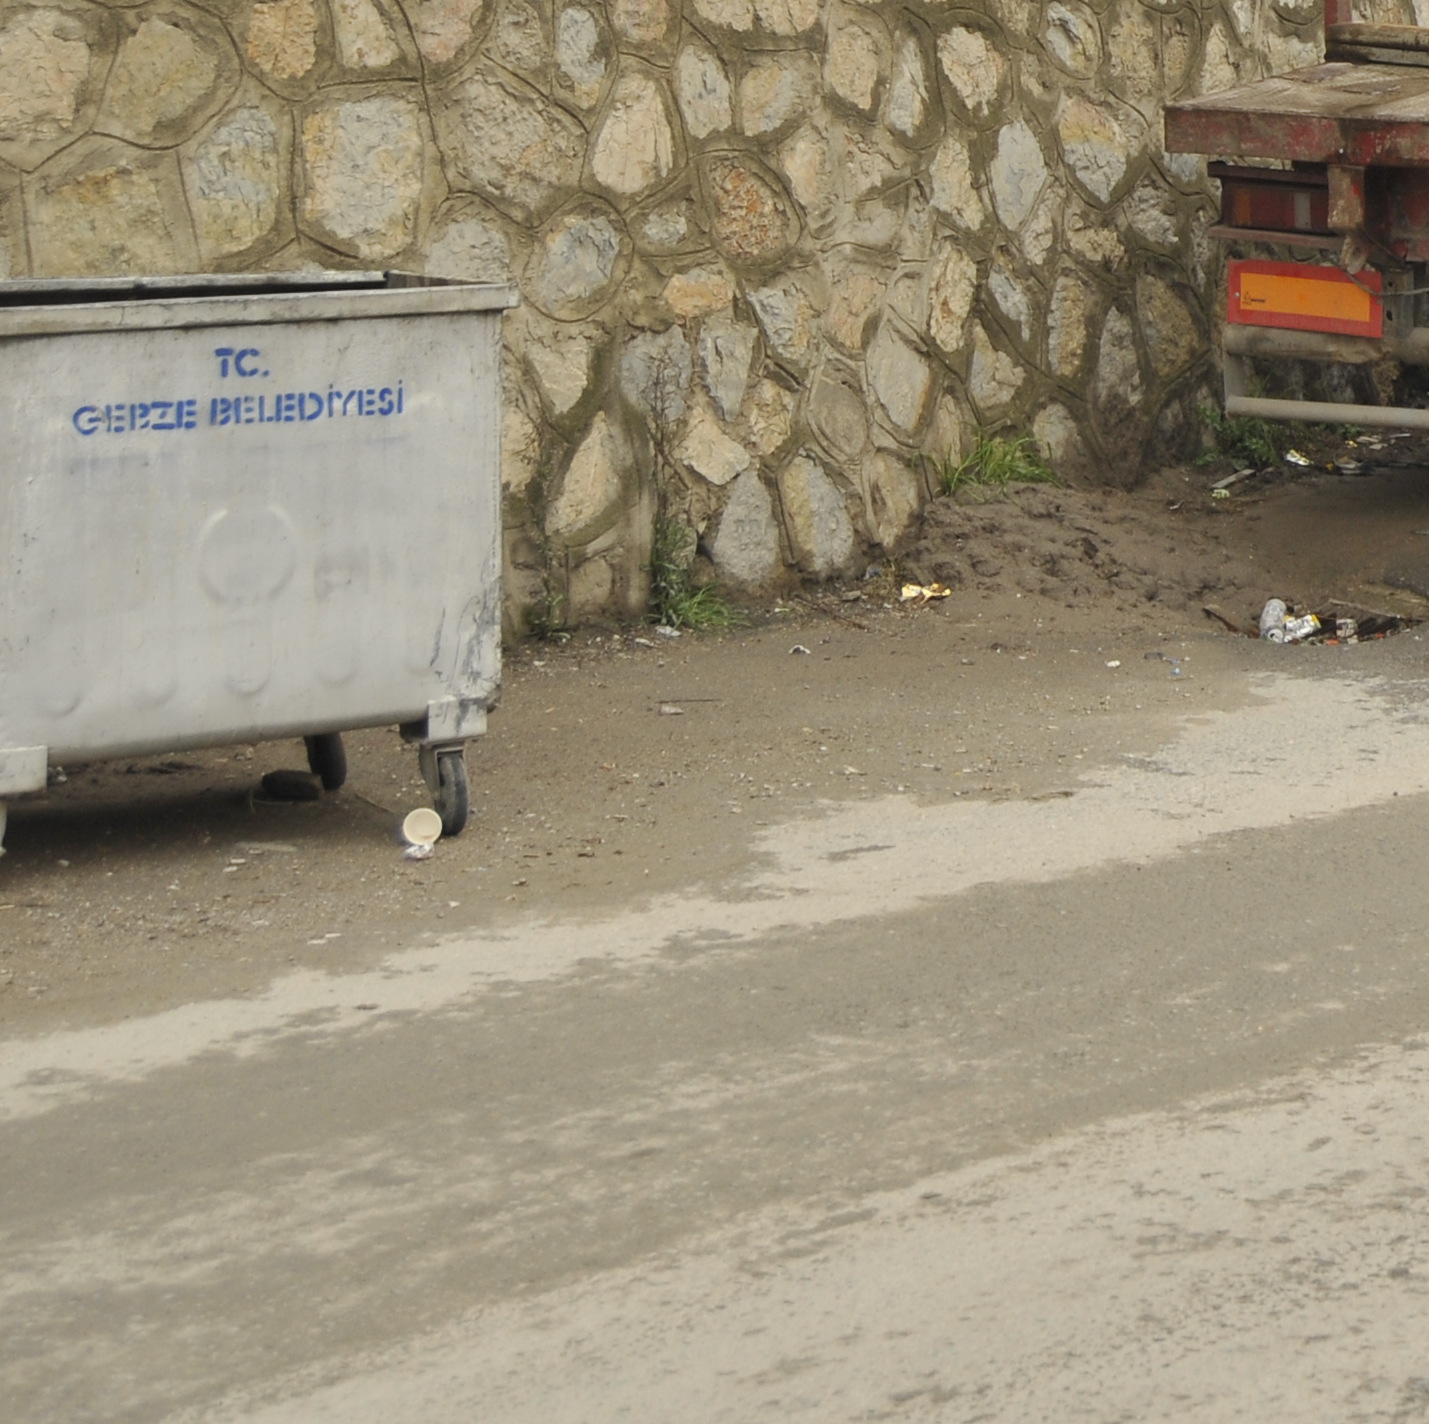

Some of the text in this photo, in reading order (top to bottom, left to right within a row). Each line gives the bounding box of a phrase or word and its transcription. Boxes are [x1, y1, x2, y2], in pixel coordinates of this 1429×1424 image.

[214, 347, 270, 378] TC.
[73, 379, 404, 436] GEBZE BELEDİYESİ
